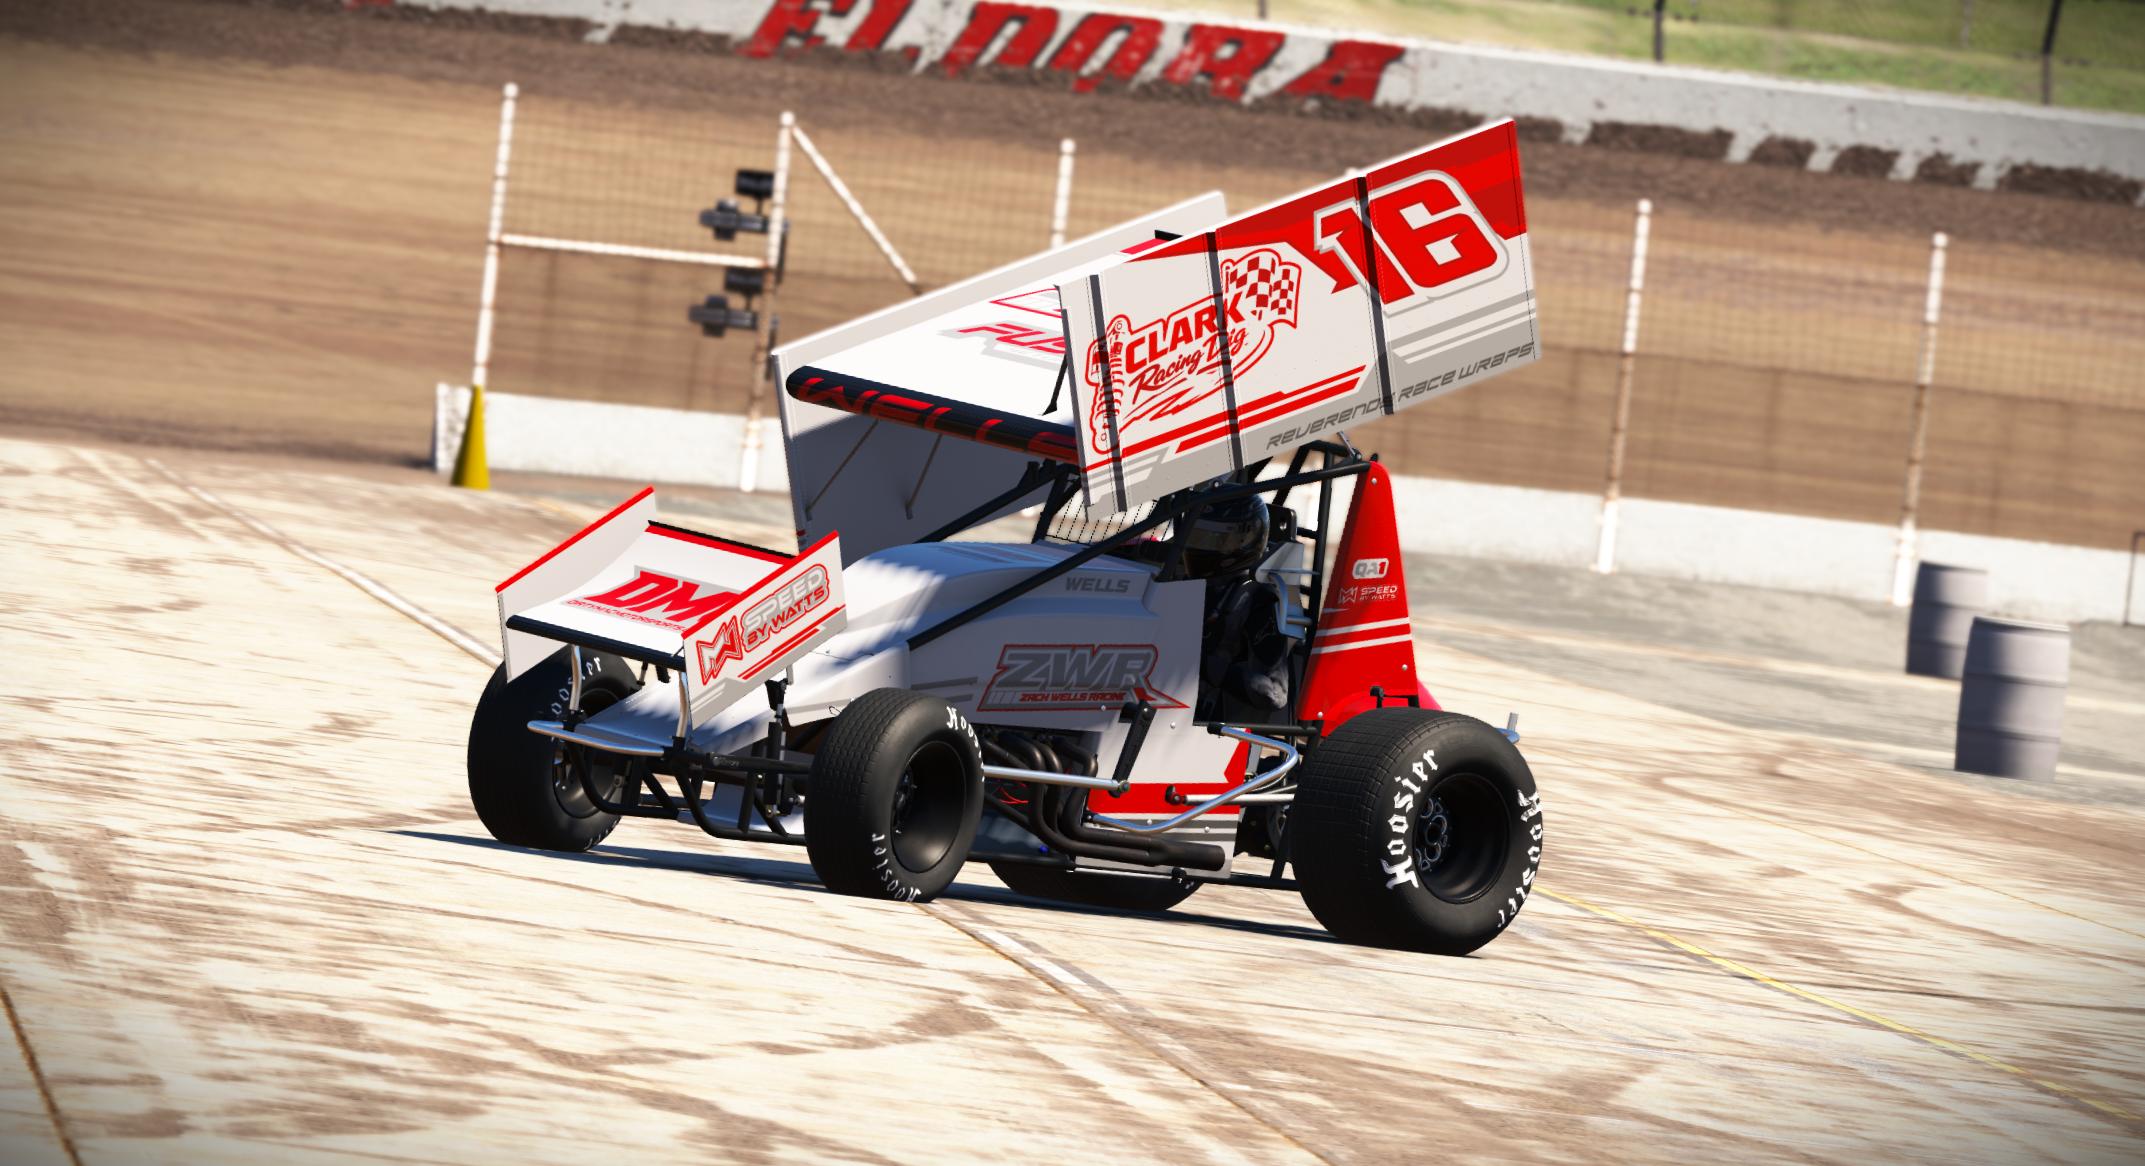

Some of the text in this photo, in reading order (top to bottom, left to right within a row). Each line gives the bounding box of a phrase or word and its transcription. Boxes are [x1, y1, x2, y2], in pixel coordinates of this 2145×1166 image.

[1316, 172, 1505, 312] 16
[1126, 291, 1246, 374] CLARK
[1128, 348, 1204, 405] Racing
[1398, 369, 1457, 402] RACE
[1457, 341, 1535, 380] WRAPS
[1065, 575, 1131, 593] WELLS
[1354, 560, 1387, 578] QA1
[1360, 585, 1398, 596] SPEED
[745, 567, 823, 631] SPEED
[747, 585, 825, 645] BY WATTS
[996, 651, 1158, 702] ZWR
[1048, 692, 1087, 702] WELLS
[1380, 749, 1439, 890] Hoosier
